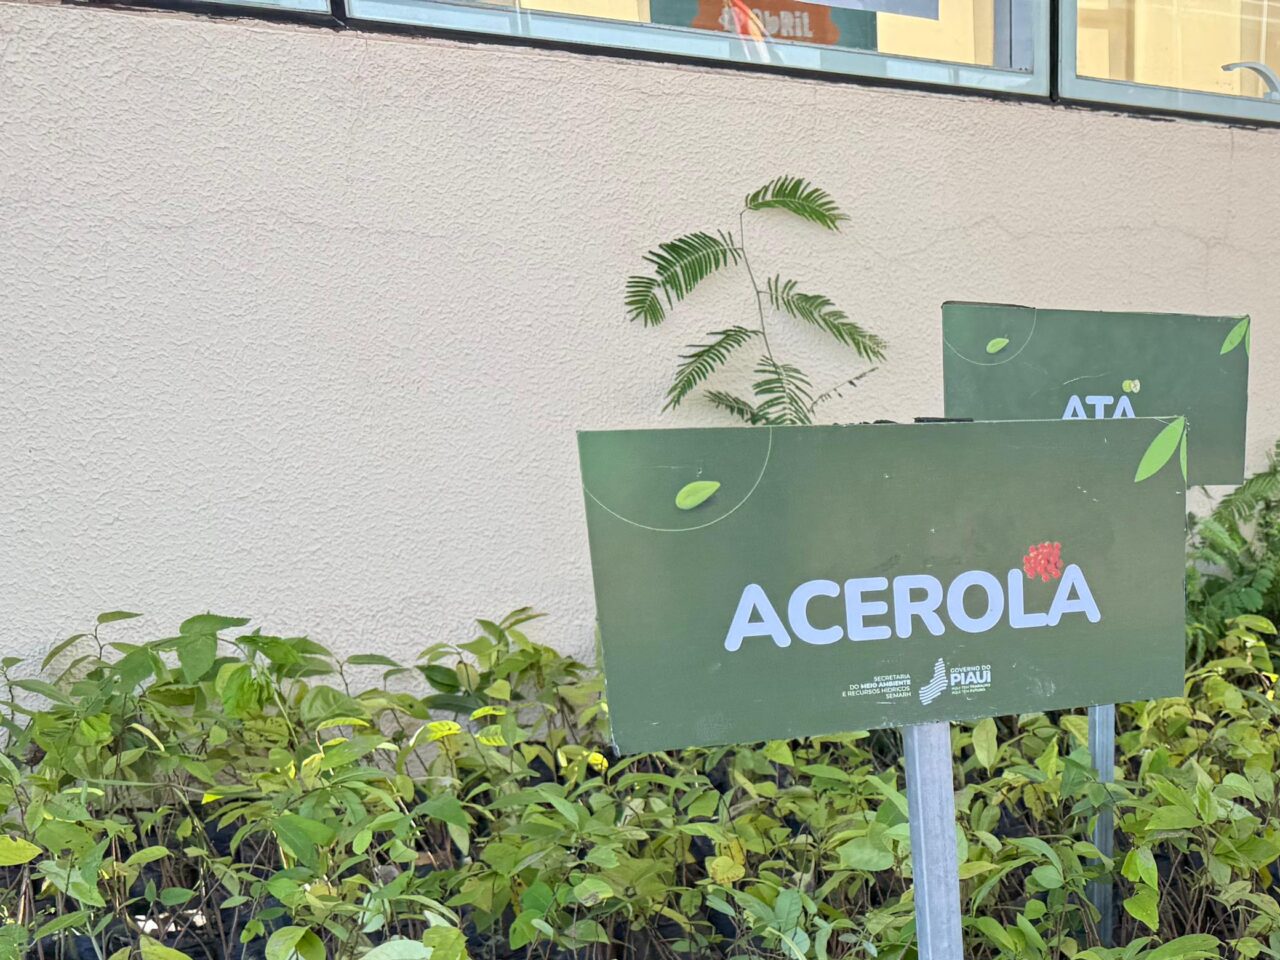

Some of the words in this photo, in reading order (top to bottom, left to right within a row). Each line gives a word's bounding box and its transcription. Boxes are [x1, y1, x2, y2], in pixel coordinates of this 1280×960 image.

[1062, 394, 1137, 420] ATA
[724, 563, 1102, 653] ACEROLA
[950, 665, 981, 674] GOVERNO
[873, 673, 911, 682] SECRETARIA
[860, 682, 878, 690] MEIO
[878, 679, 912, 688] AMBIENTE
[847, 688, 881, 698] RECURSOS
[886, 691, 912, 700] SEMARH
